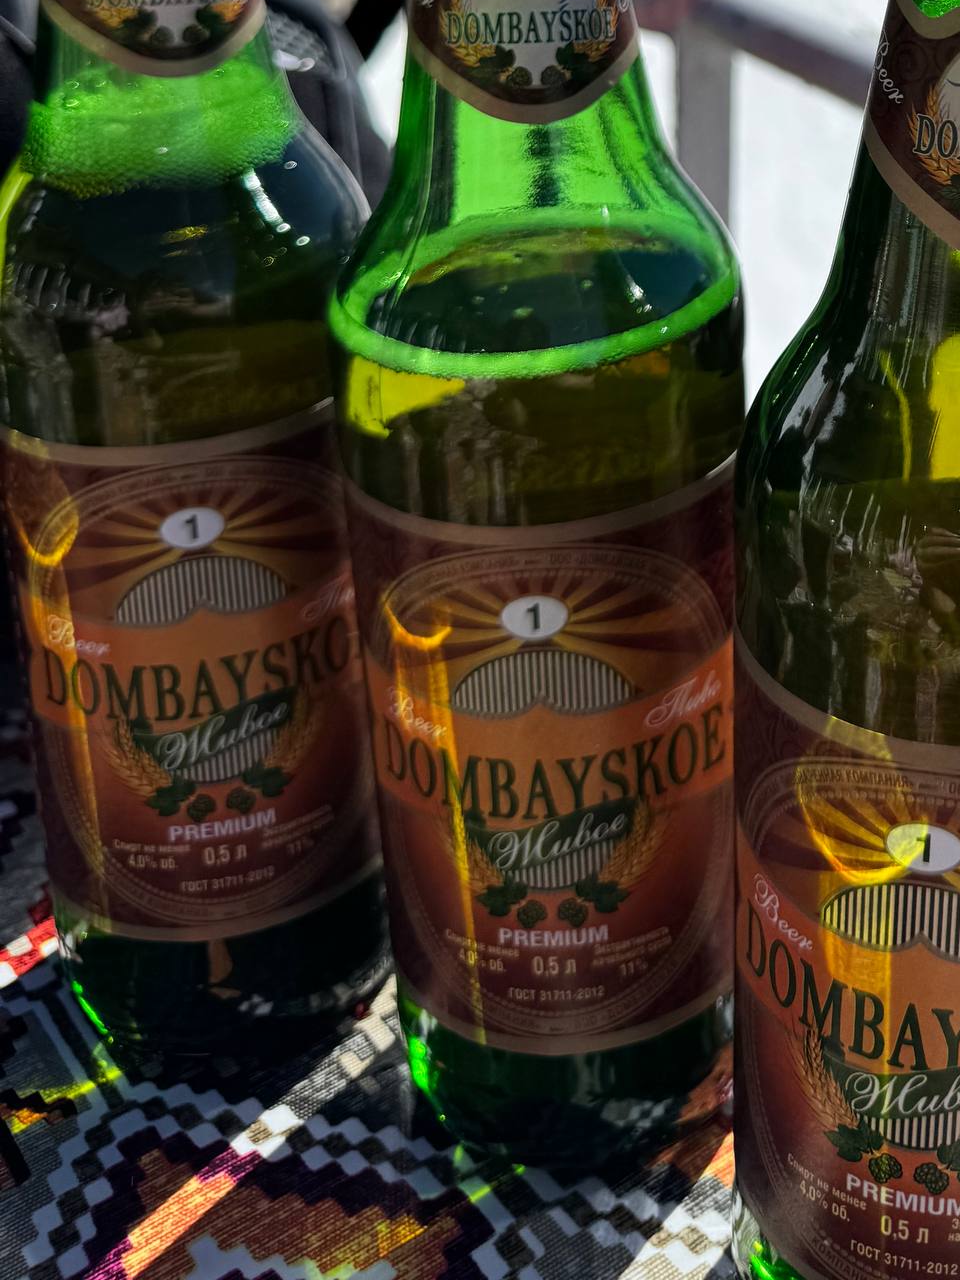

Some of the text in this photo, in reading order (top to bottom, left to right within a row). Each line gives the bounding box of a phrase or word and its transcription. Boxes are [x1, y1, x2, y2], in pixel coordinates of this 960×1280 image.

[446, 7, 616, 45] DOMBAYSKOE
[186, 513, 199, 541] 1
[527, 602, 541, 630] 1
[42, 615, 352, 722] DOMBAYSKO
[155, 701, 291, 770] Живое
[384, 701, 726, 820] DOMBAYSKOE
[167, 808, 277, 842] PREMIUM
[203, 844, 231, 866] 0,5
[489, 811, 627, 873] Живое
[917, 832, 931, 863] 1
[498, 923, 609, 947] PREMIUM
[532, 955, 577, 977] 0,5 л
[508, 986, 536, 1001] ГОСТ
[787, 1152, 868, 1211] Спирт не менее
[880, 1214, 930, 1244] 0,5 л
[850, 1239, 959, 1276] ГОСТ 31711-2012
